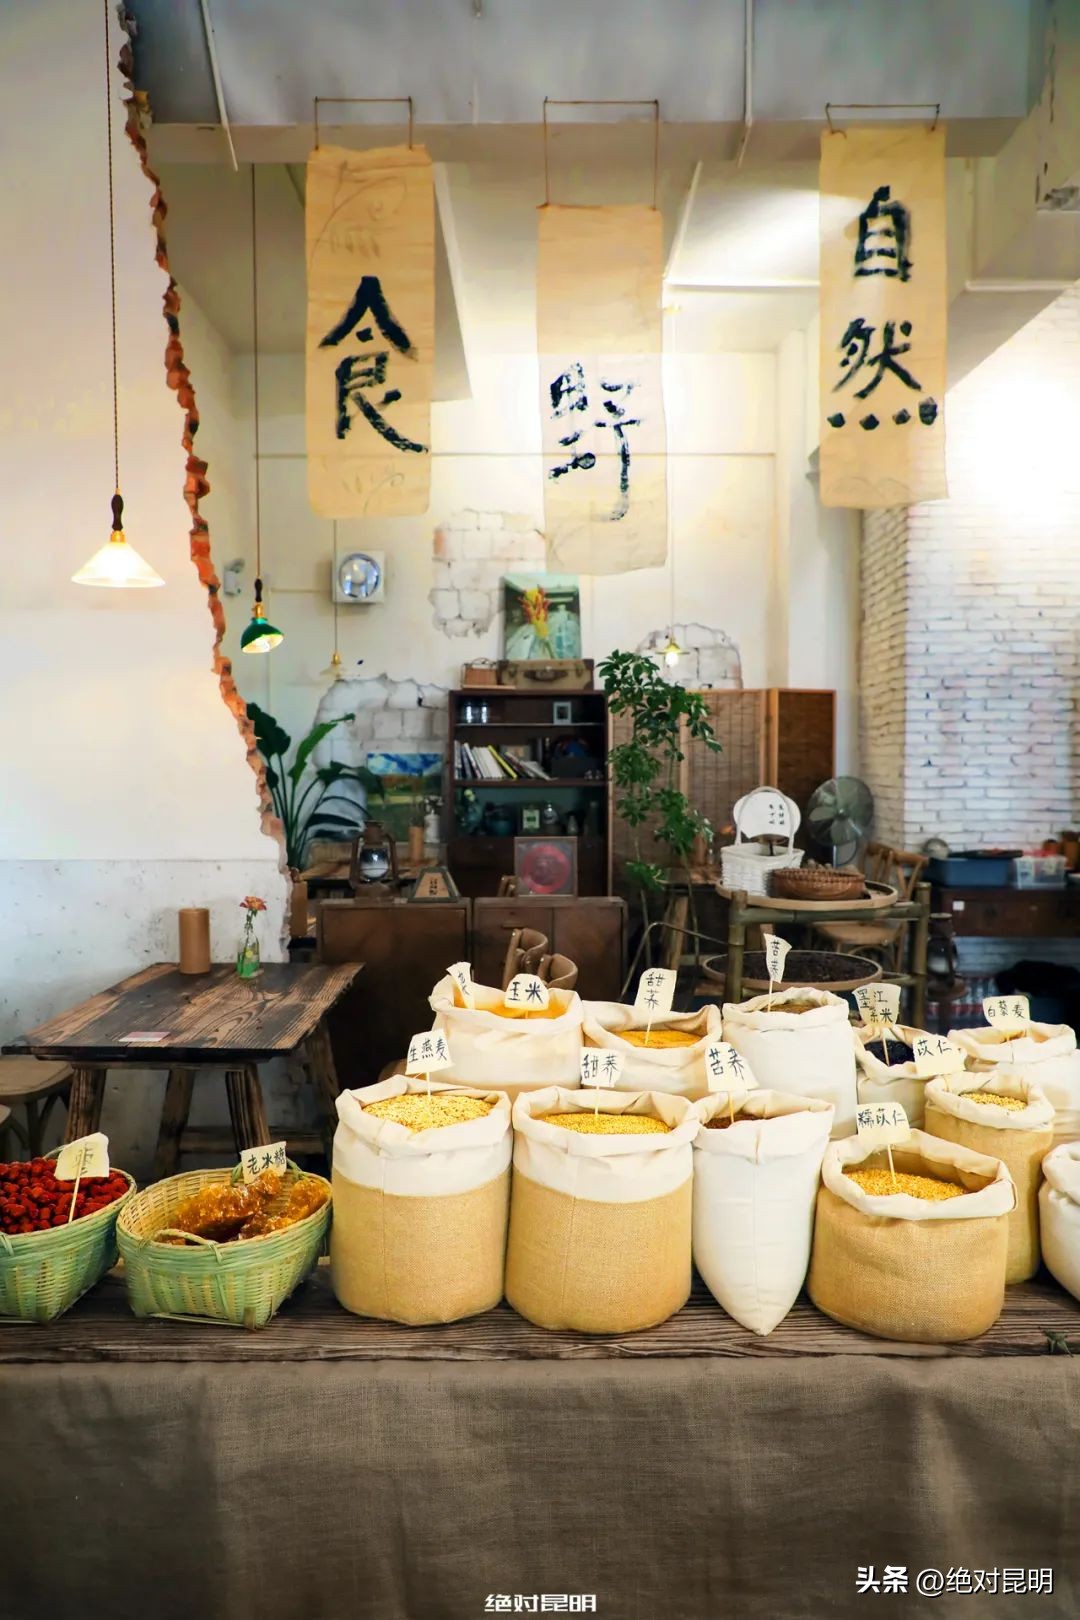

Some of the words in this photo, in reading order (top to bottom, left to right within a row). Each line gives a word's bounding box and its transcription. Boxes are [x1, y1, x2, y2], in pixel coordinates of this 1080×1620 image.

[826, 185, 938, 430] 自然
[318, 276, 429, 452] 食
[507, 981, 544, 1003] 玉米
[409, 1037, 447, 1063] 生燕麦
[709, 1048, 745, 1081] 苦荞
[581, 1053, 618, 1083] 甜荞
[247, 1147, 286, 1175] 老冰糖
